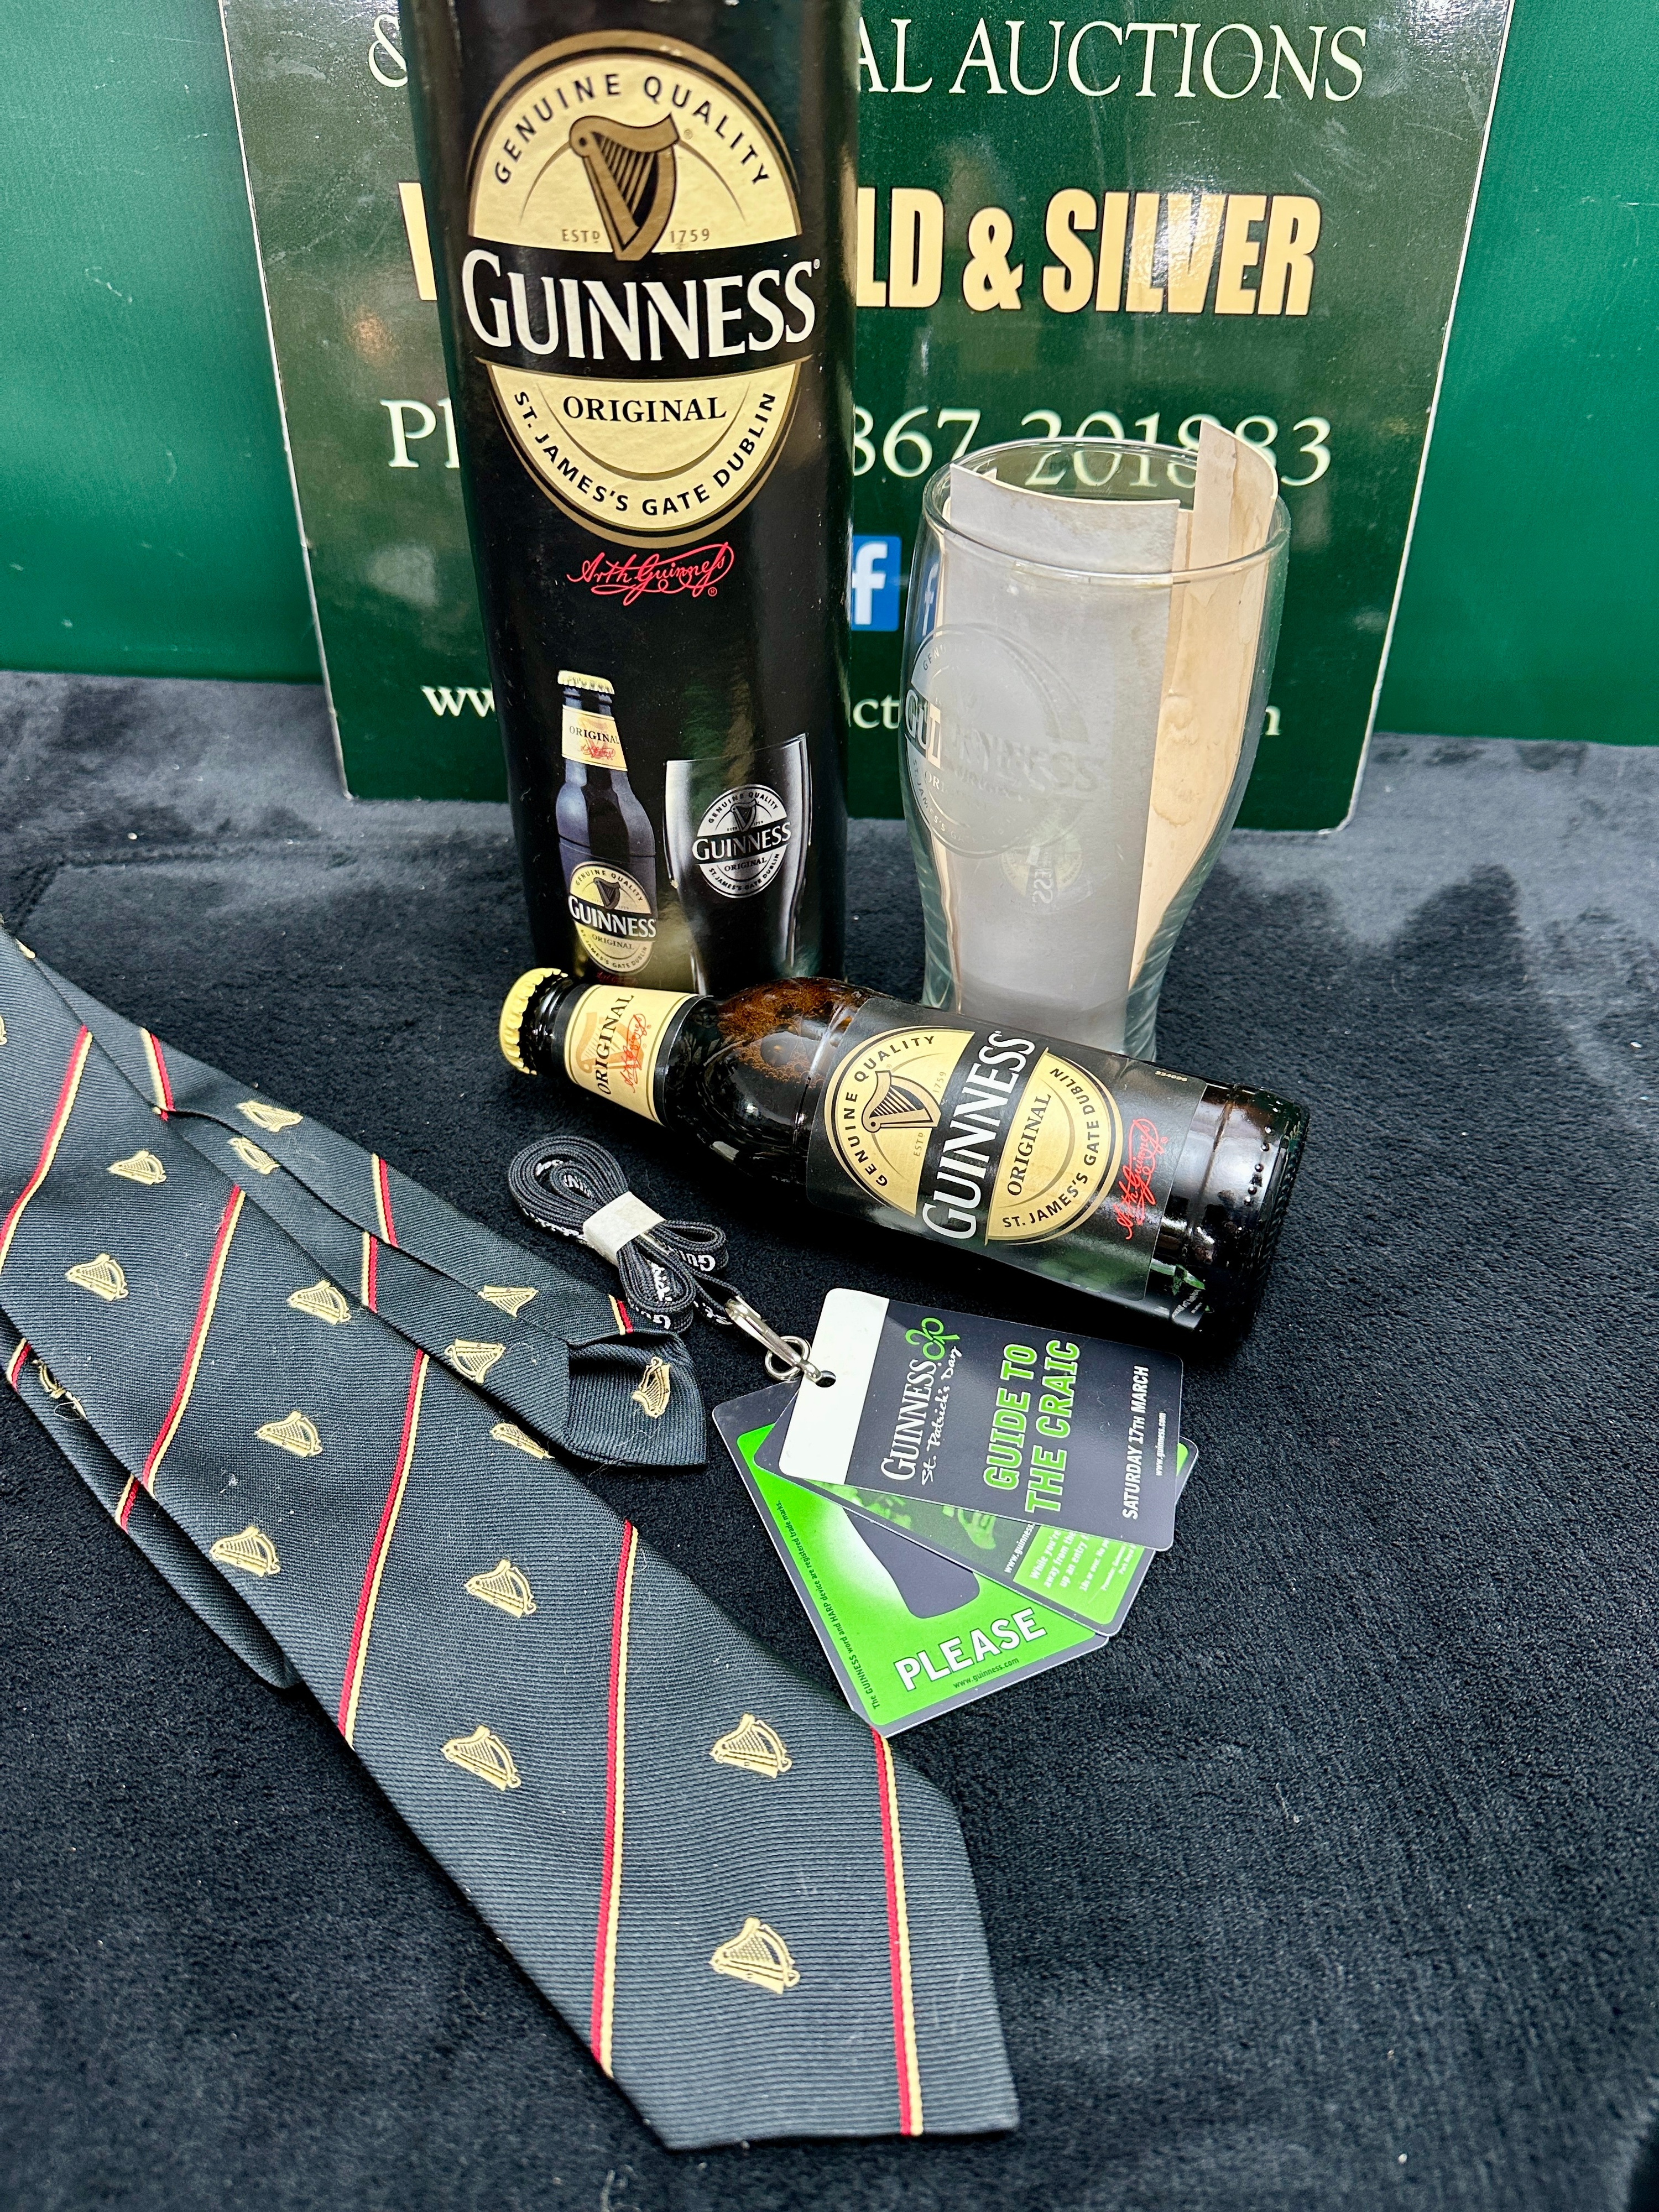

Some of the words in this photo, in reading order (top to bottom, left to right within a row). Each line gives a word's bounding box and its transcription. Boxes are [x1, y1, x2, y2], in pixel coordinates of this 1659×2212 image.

[948, 17, 1366, 102] AUCTIONS
[495, 72, 620, 186] GENUINE
[643, 76, 770, 187] QUALITY
[670, 228, 710, 243] 1759
[962, 206, 1024, 311] &
[1042, 188, 1322, 316] SILVER
[461, 249, 816, 362] GUINNESS
[563, 395, 727, 422] ORIGINAL
[514, 390, 538, 429] ST.
[535, 433, 629, 512] JAMES'S
[642, 483, 710, 516] GATE
[712, 393, 777, 488] DUBLIN
[570, 726, 620, 744] ORIGINAL
[708, 793, 744, 823] GENUINE
[749, 792, 778, 810] QUALITY
[692, 822, 791, 860] GUINNESS
[576, 869, 607, 886] GENUINE
[611, 873, 644, 902] QUALITY
[724, 857, 767, 872] ORIGINAL
[763, 854, 780, 879] DUBLIN
[568, 895, 656, 938] GUINNESS
[592, 933, 635, 950] ORIGINAL
[632, 946, 648, 967] DUBLIN
[596, 995, 635, 1095] ORIGINAL
[854, 1036, 935, 1082] QUALITY
[932, 1071, 947, 1093] 1759
[1050, 1068, 1097, 1115] DUBLIN
[844, 1092, 888, 1187] GENUINE
[922, 1032, 1035, 1240] GUINNESS
[1007, 1094, 1051, 1196] ORIGINAL
[1084, 1120, 1100, 1166] GATE
[1030, 1172, 1088, 1224] JAMES'S
[1002, 1217, 1026, 1228] ST.
[941, 1345, 962, 1380] Day
[1000, 1343, 1037, 1381] TO
[1035, 1340, 1080, 1439] CRAIC
[1130, 1365, 1149, 1413] MARCH
[880, 1359, 937, 1481] GUINNESS
[926, 1386, 950, 1452] Patrick's
[983, 1387, 1031, 1490] GUIDE
[1155, 1412, 1167, 1477] www.guinness.com
[921, 1455, 937, 1485] St.
[1024, 1444, 1067, 1514] THE
[1121, 1445, 1142, 1520] SATURDAY
[776, 1500, 791, 1521] marks.
[784, 1520, 797, 1538] trade
[791, 1535, 816, 1569] registered
[1029, 1556, 1048, 1580] While
[1044, 1530, 1062, 1557] you're
[1044, 1566, 1060, 1589] away
[1053, 1545, 1070, 1566] from
[1063, 1531, 1077, 1545] the
[1060, 1575, 1071, 1588] up
[1066, 1563, 1076, 1576] an
[1071, 1541, 1088, 1563] entry
[809, 1567, 820, 1580] are
[814, 1579, 829, 1604] device
[823, 1602, 838, 1623] HARP
[833, 1621, 846, 1637] and
[841, 1635, 854, 1655] word
[893, 1606, 1048, 1692] PLEASE
[849, 1653, 874, 1694] GUINNESS
[953, 1657, 1020, 1689] www.guinness.com
[870, 1693, 881, 1710] The
